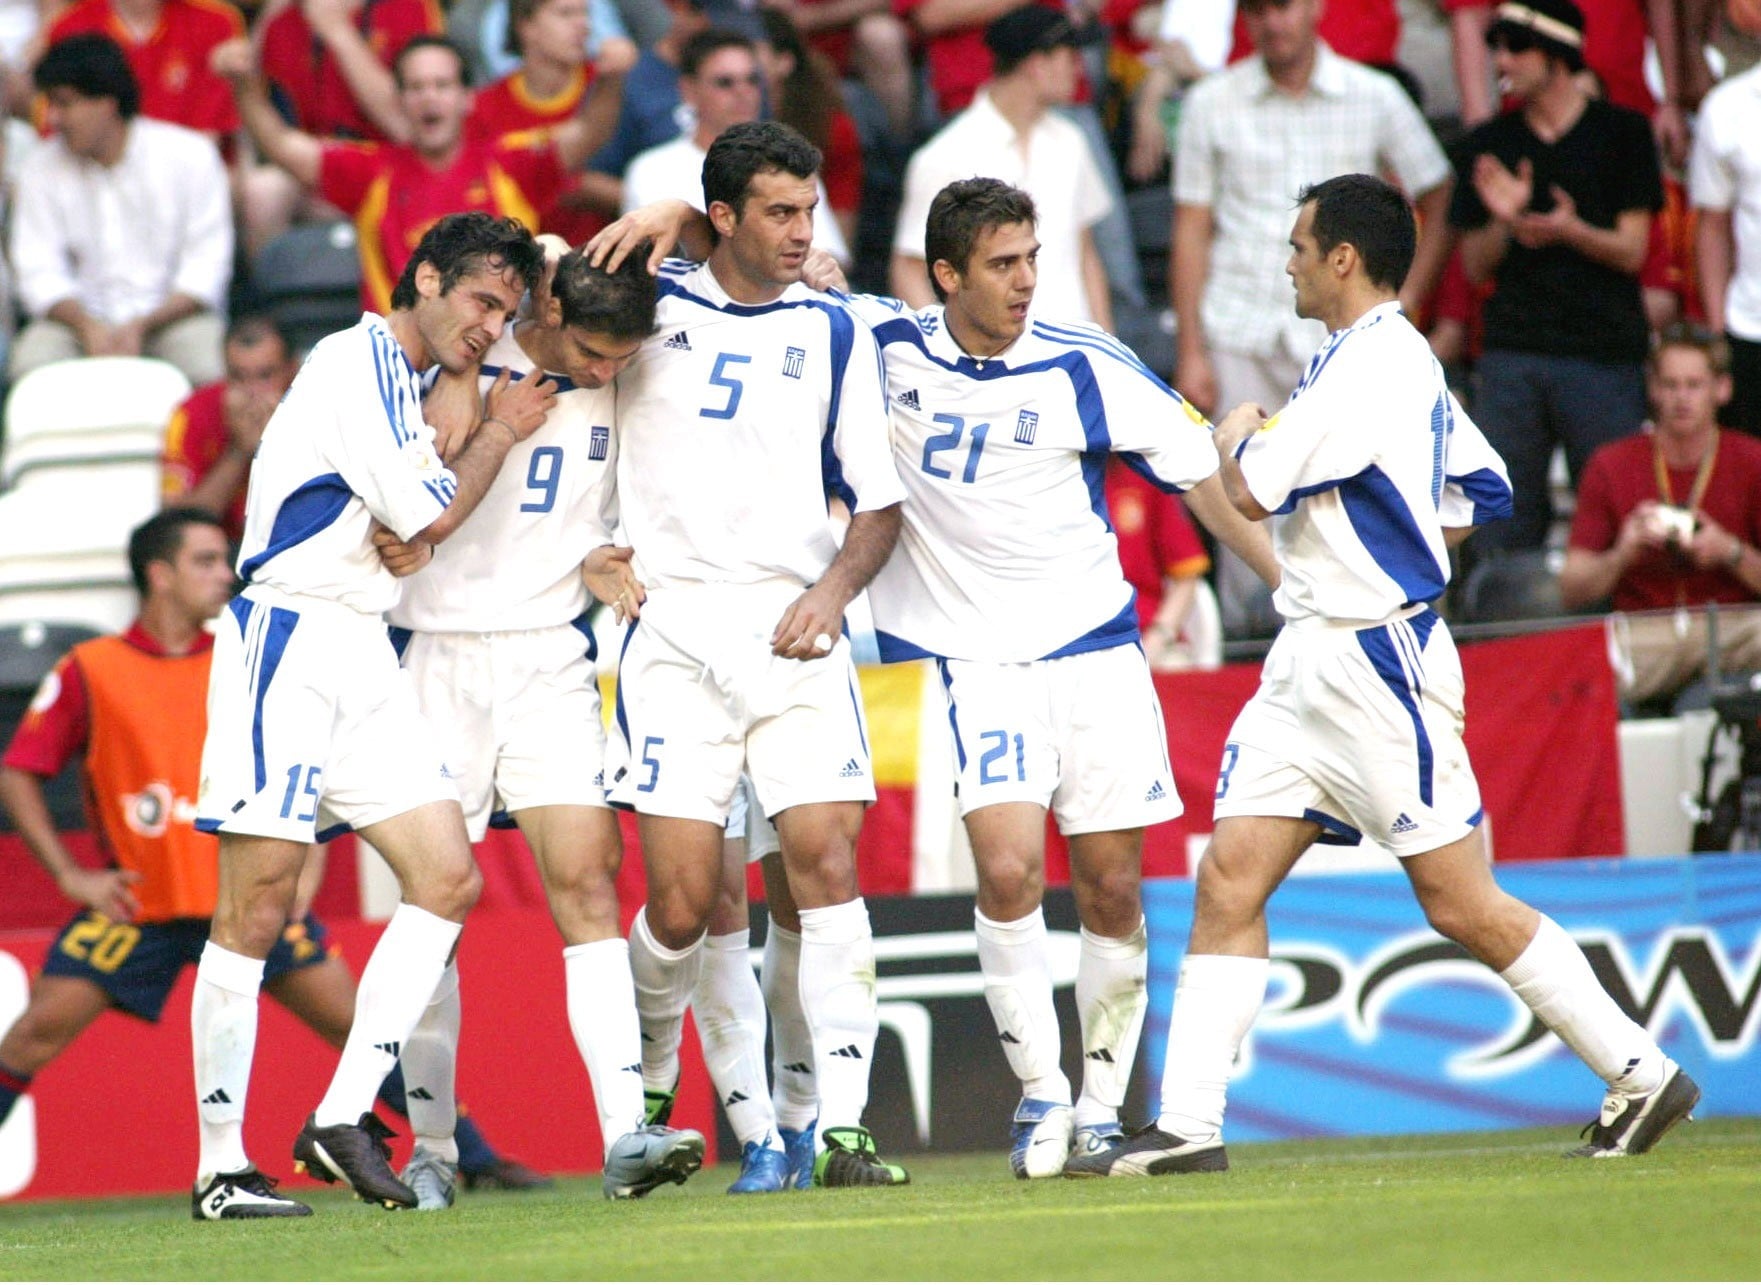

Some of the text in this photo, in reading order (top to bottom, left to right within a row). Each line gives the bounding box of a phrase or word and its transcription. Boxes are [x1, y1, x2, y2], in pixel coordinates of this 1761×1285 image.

[699, 351, 752, 420] 5
[520, 446, 564, 513] 9
[921, 412, 990, 483] 21
[636, 736, 665, 793] 5
[980, 730, 1025, 786] 21
[279, 764, 322, 822] 15
[60, 910, 142, 974] 20
